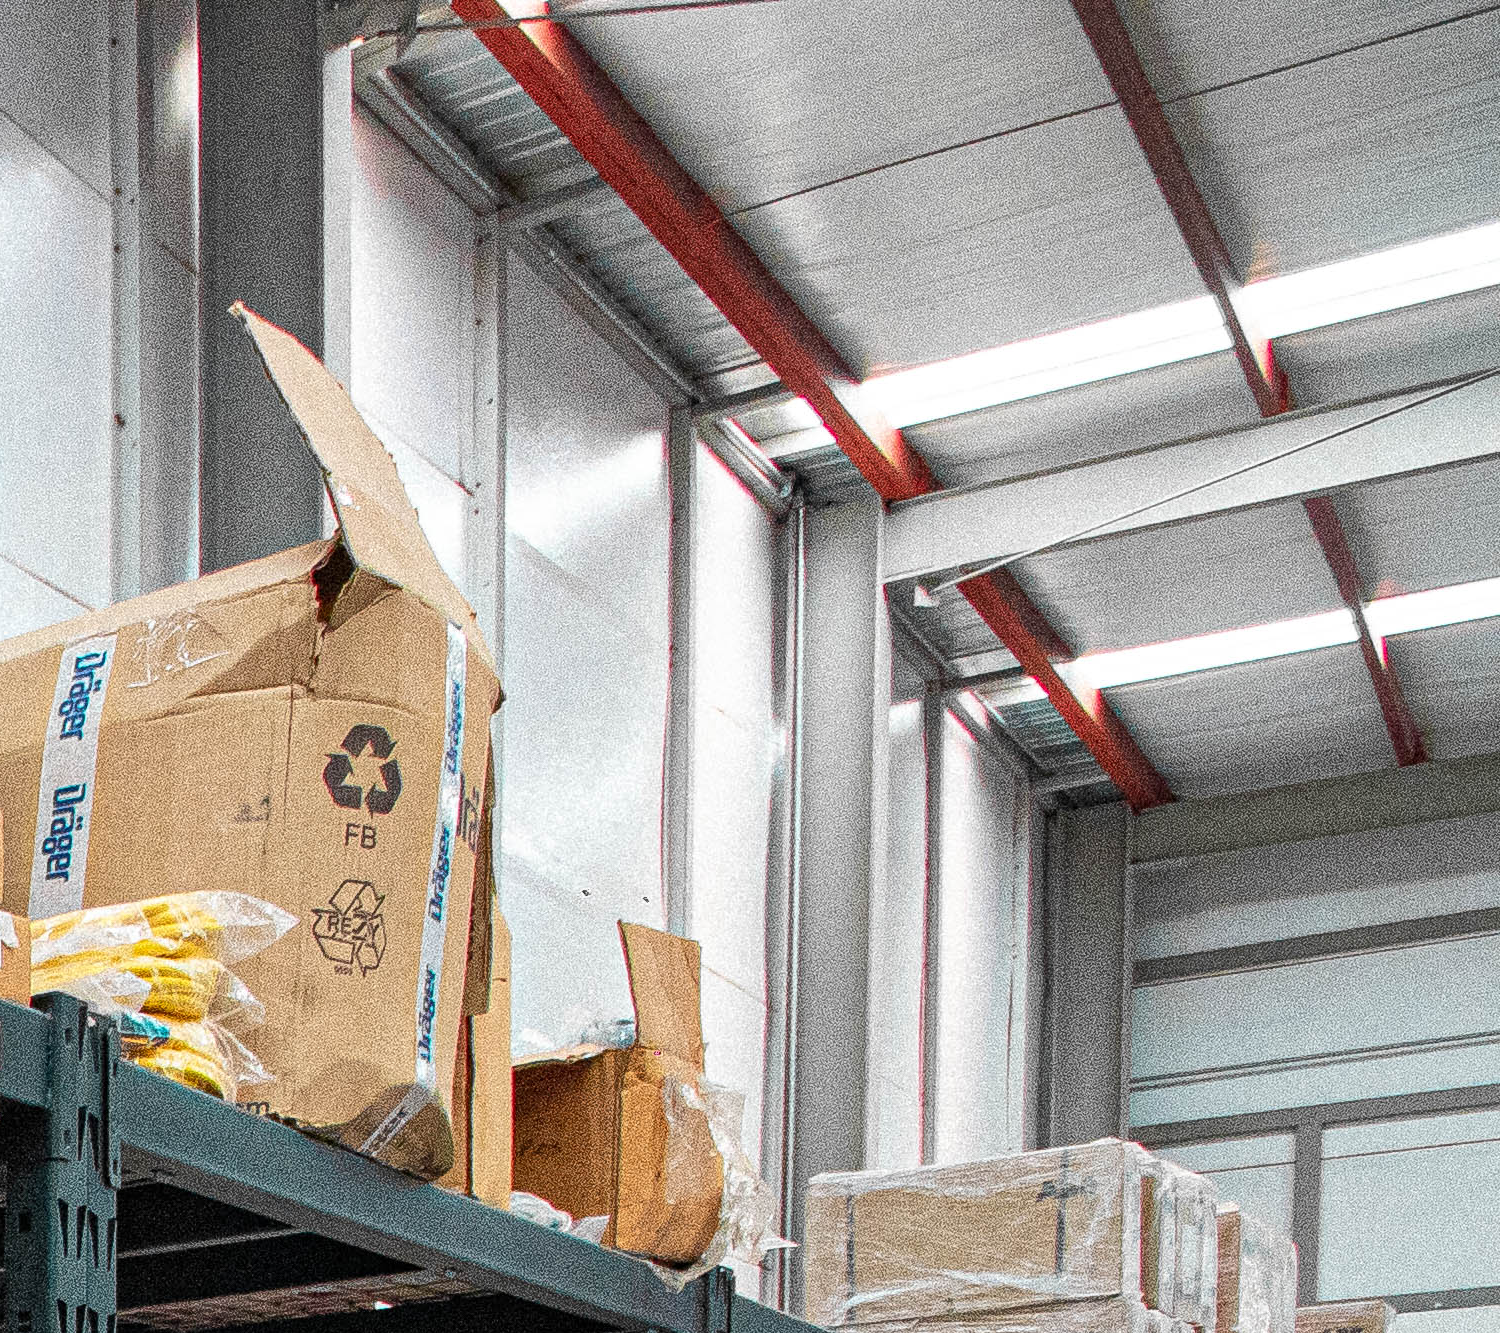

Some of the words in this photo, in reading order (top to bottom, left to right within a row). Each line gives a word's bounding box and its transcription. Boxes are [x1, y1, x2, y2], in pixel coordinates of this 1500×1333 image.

[58, 651, 107, 742] Dräger
[43, 783, 88, 883] Dräger
[345, 823, 377, 850] FB
[429, 825, 453, 922] Dräger
